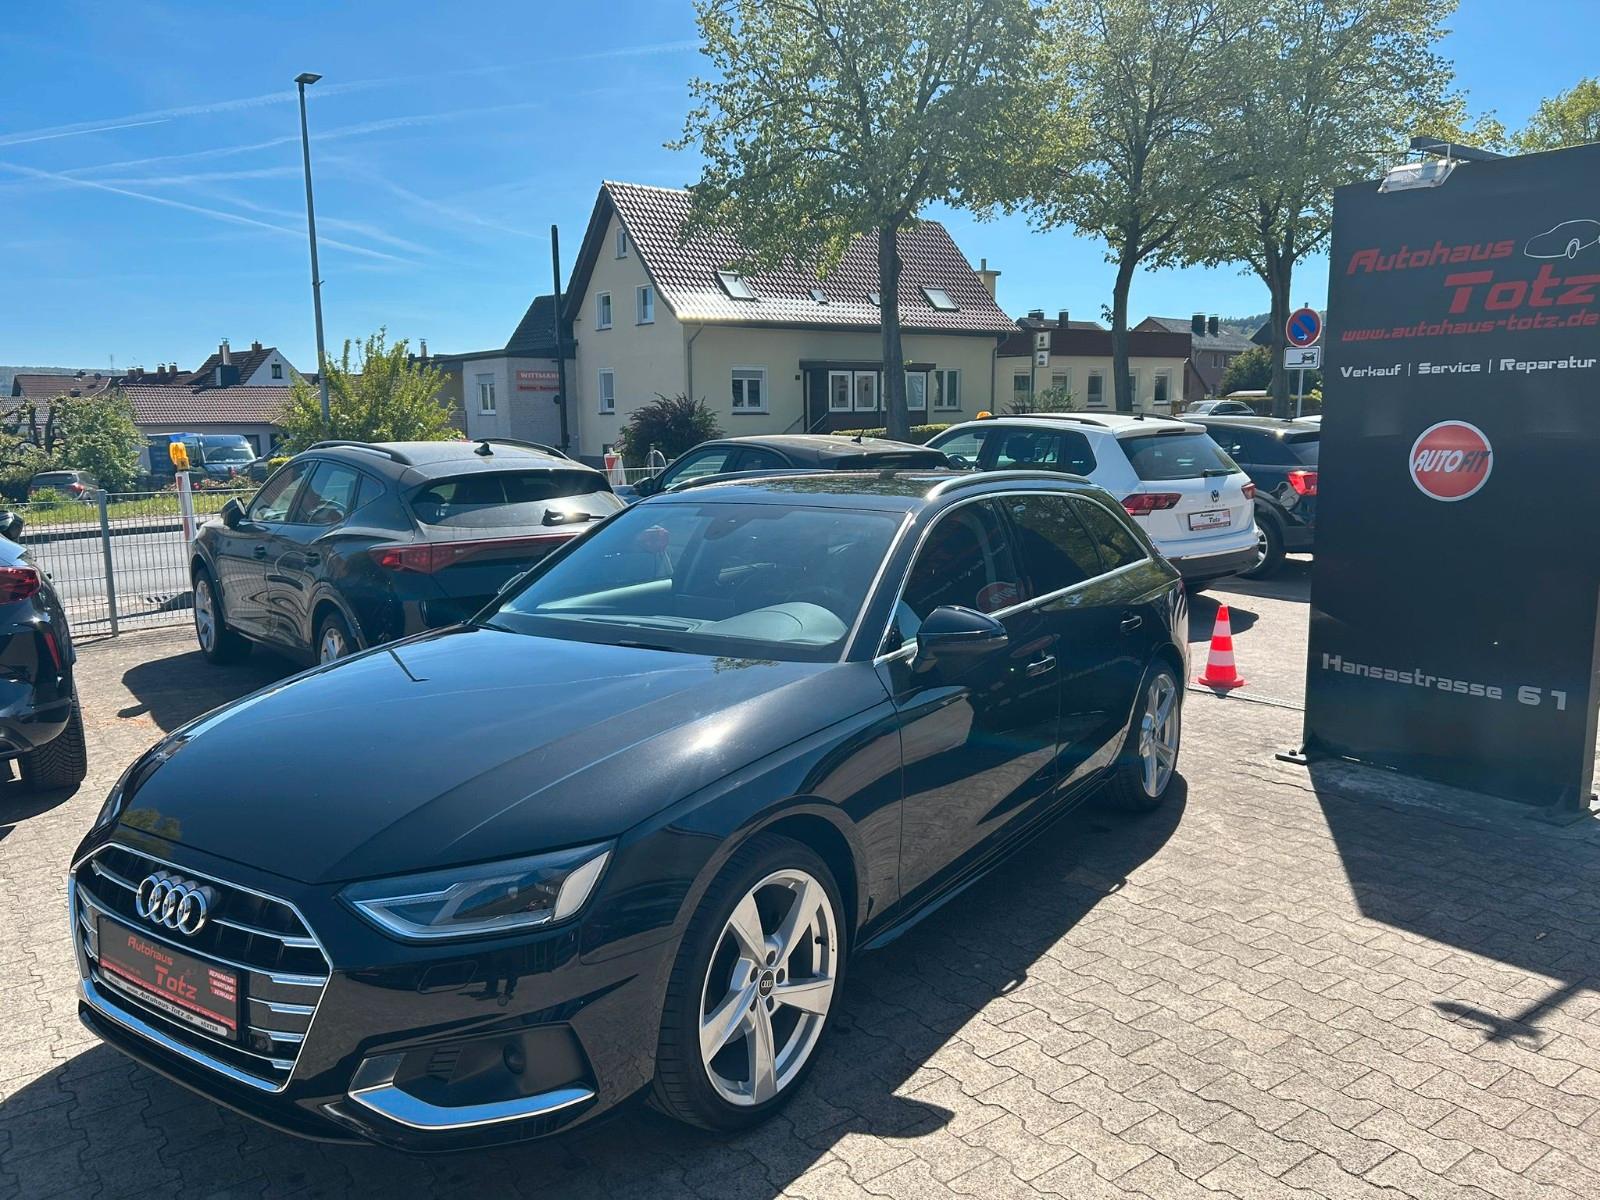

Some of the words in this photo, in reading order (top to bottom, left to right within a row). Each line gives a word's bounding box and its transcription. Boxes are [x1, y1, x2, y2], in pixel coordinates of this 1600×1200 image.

[1347, 240, 1515, 275] Autohaus
[1444, 263, 1600, 314] Totz
[1341, 309, 1600, 341] www.autohaus-totz.de
[1340, 363, 1402, 378] Verkauf
[1418, 361, 1481, 375] Service
[1500, 355, 1597, 374] Reparatur
[1413, 449, 1491, 473] AUTOFIT
[1322, 652, 1503, 700] Hansastrasse
[127, 935, 173, 965] Autohaus
[155, 964, 198, 1000] Totz
